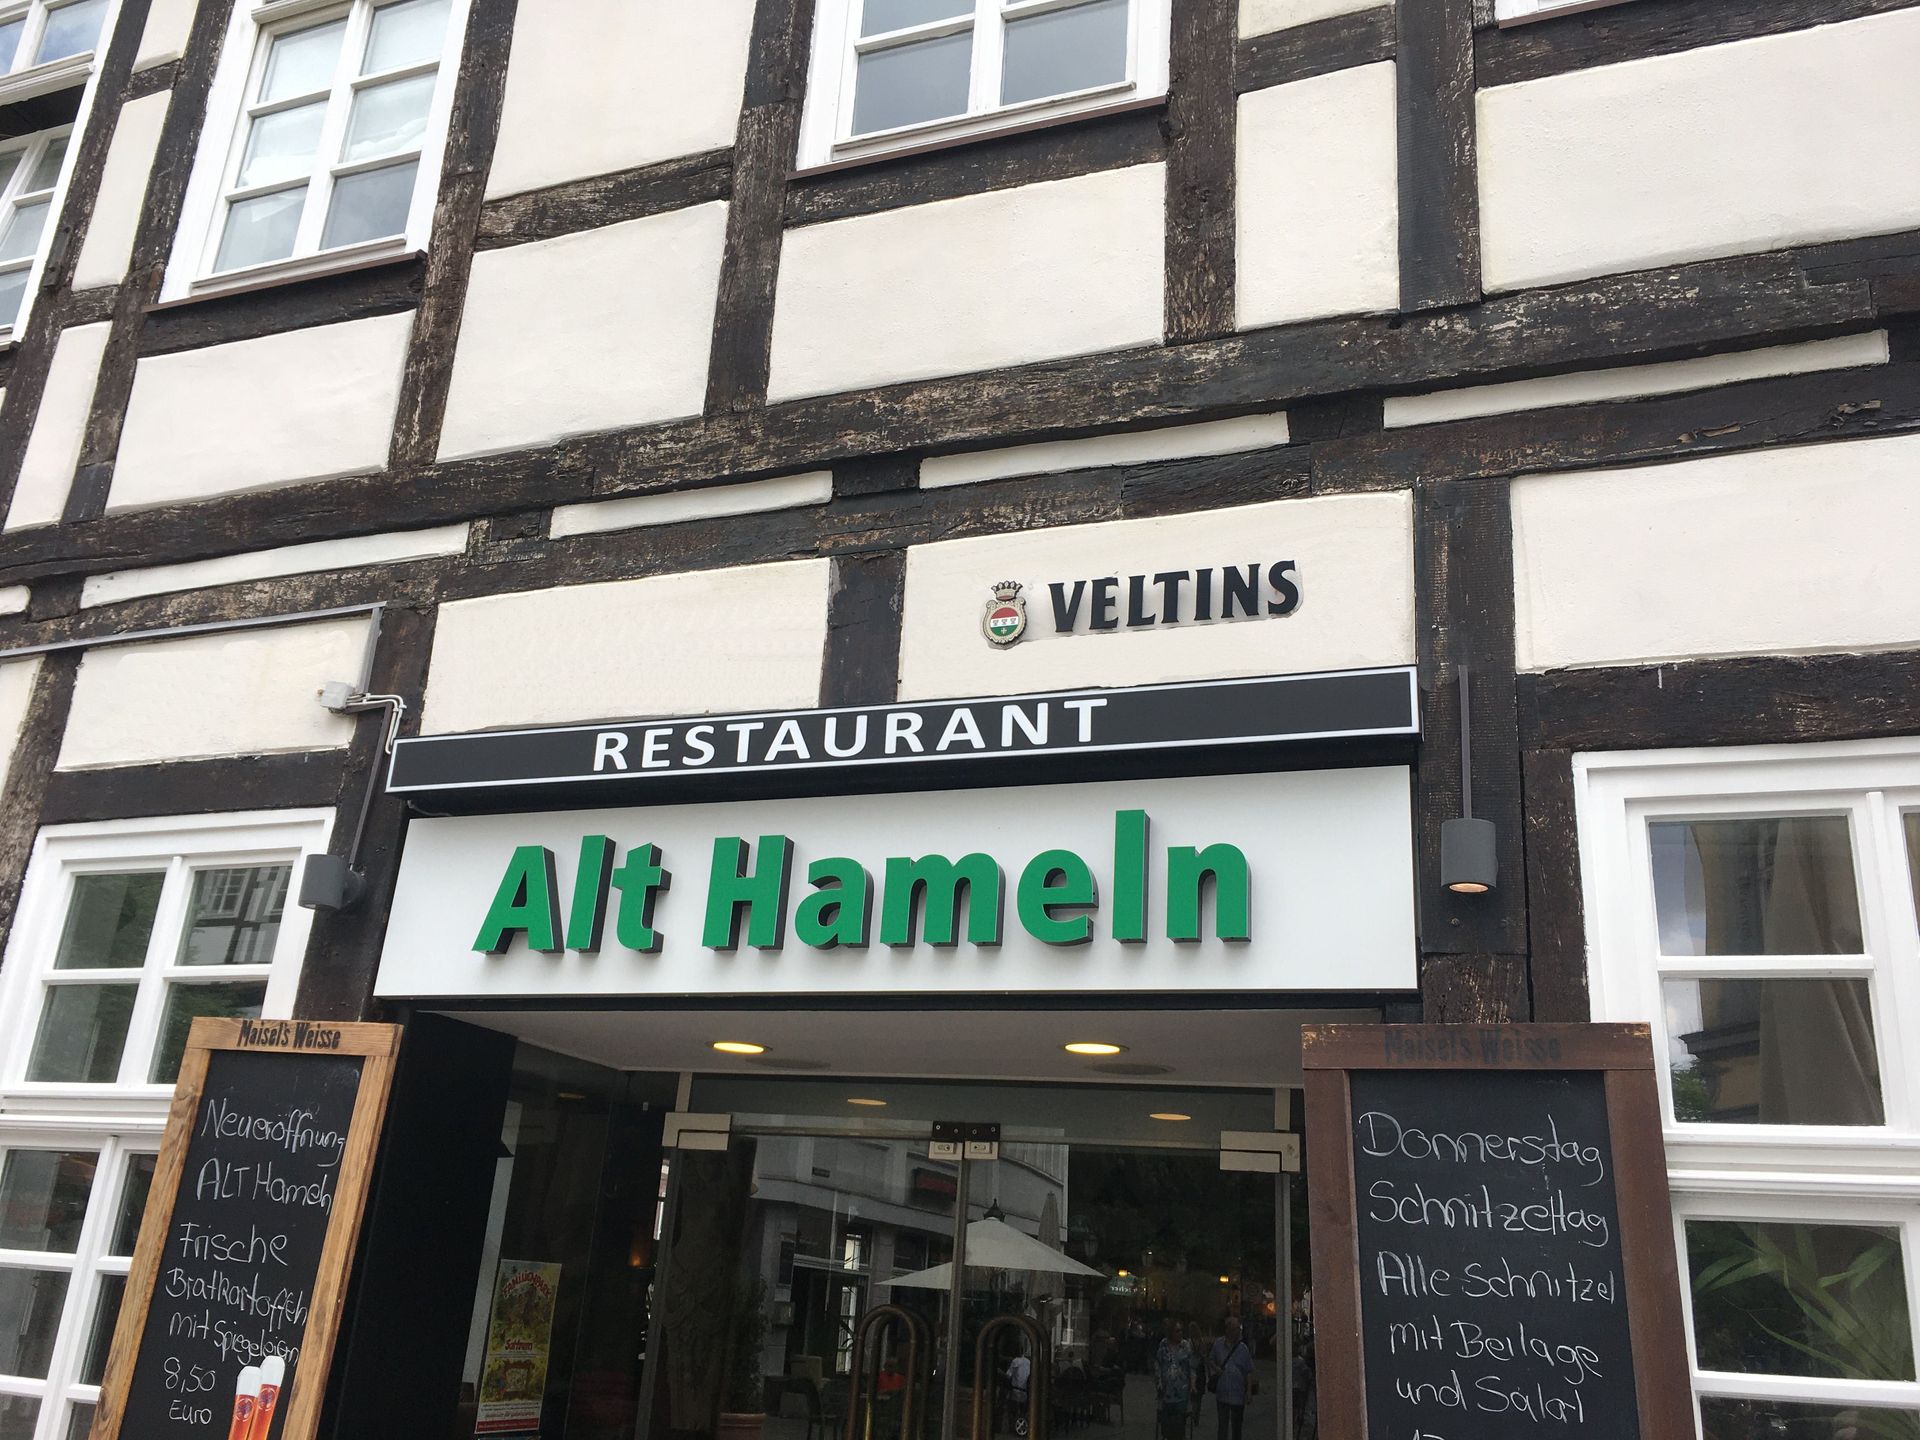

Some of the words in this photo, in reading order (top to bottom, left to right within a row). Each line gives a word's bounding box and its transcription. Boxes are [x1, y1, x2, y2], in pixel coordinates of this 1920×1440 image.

[1047, 560, 1300, 633] VELTINS
[593, 697, 1109, 772] RESTAURANT
[472, 834, 673, 955] Alt
[702, 809, 1252, 952] Hameln
[236, 1020, 290, 1047] Maisel's
[293, 1022, 341, 1050] Weisse
[1477, 1026, 1562, 1064] Weisse
[200, 1098, 346, 1167] Neueröffnung
[1358, 1111, 1605, 1187] Donnerstag
[179, 1222, 289, 1266] Frische
[1368, 1180, 1610, 1248] Schnitzeltag
[1376, 1250, 1452, 1298] Alle
[1461, 1256, 1615, 1305] Schnitzel
[163, 1356, 217, 1393] 8,50
[1389, 1314, 1444, 1355] mit
[1450, 1320, 1603, 1385] Beilage
[168, 1399, 213, 1425] Euro
[1396, 1369, 1468, 1411] und
[1475, 1375, 1585, 1424] Salat
